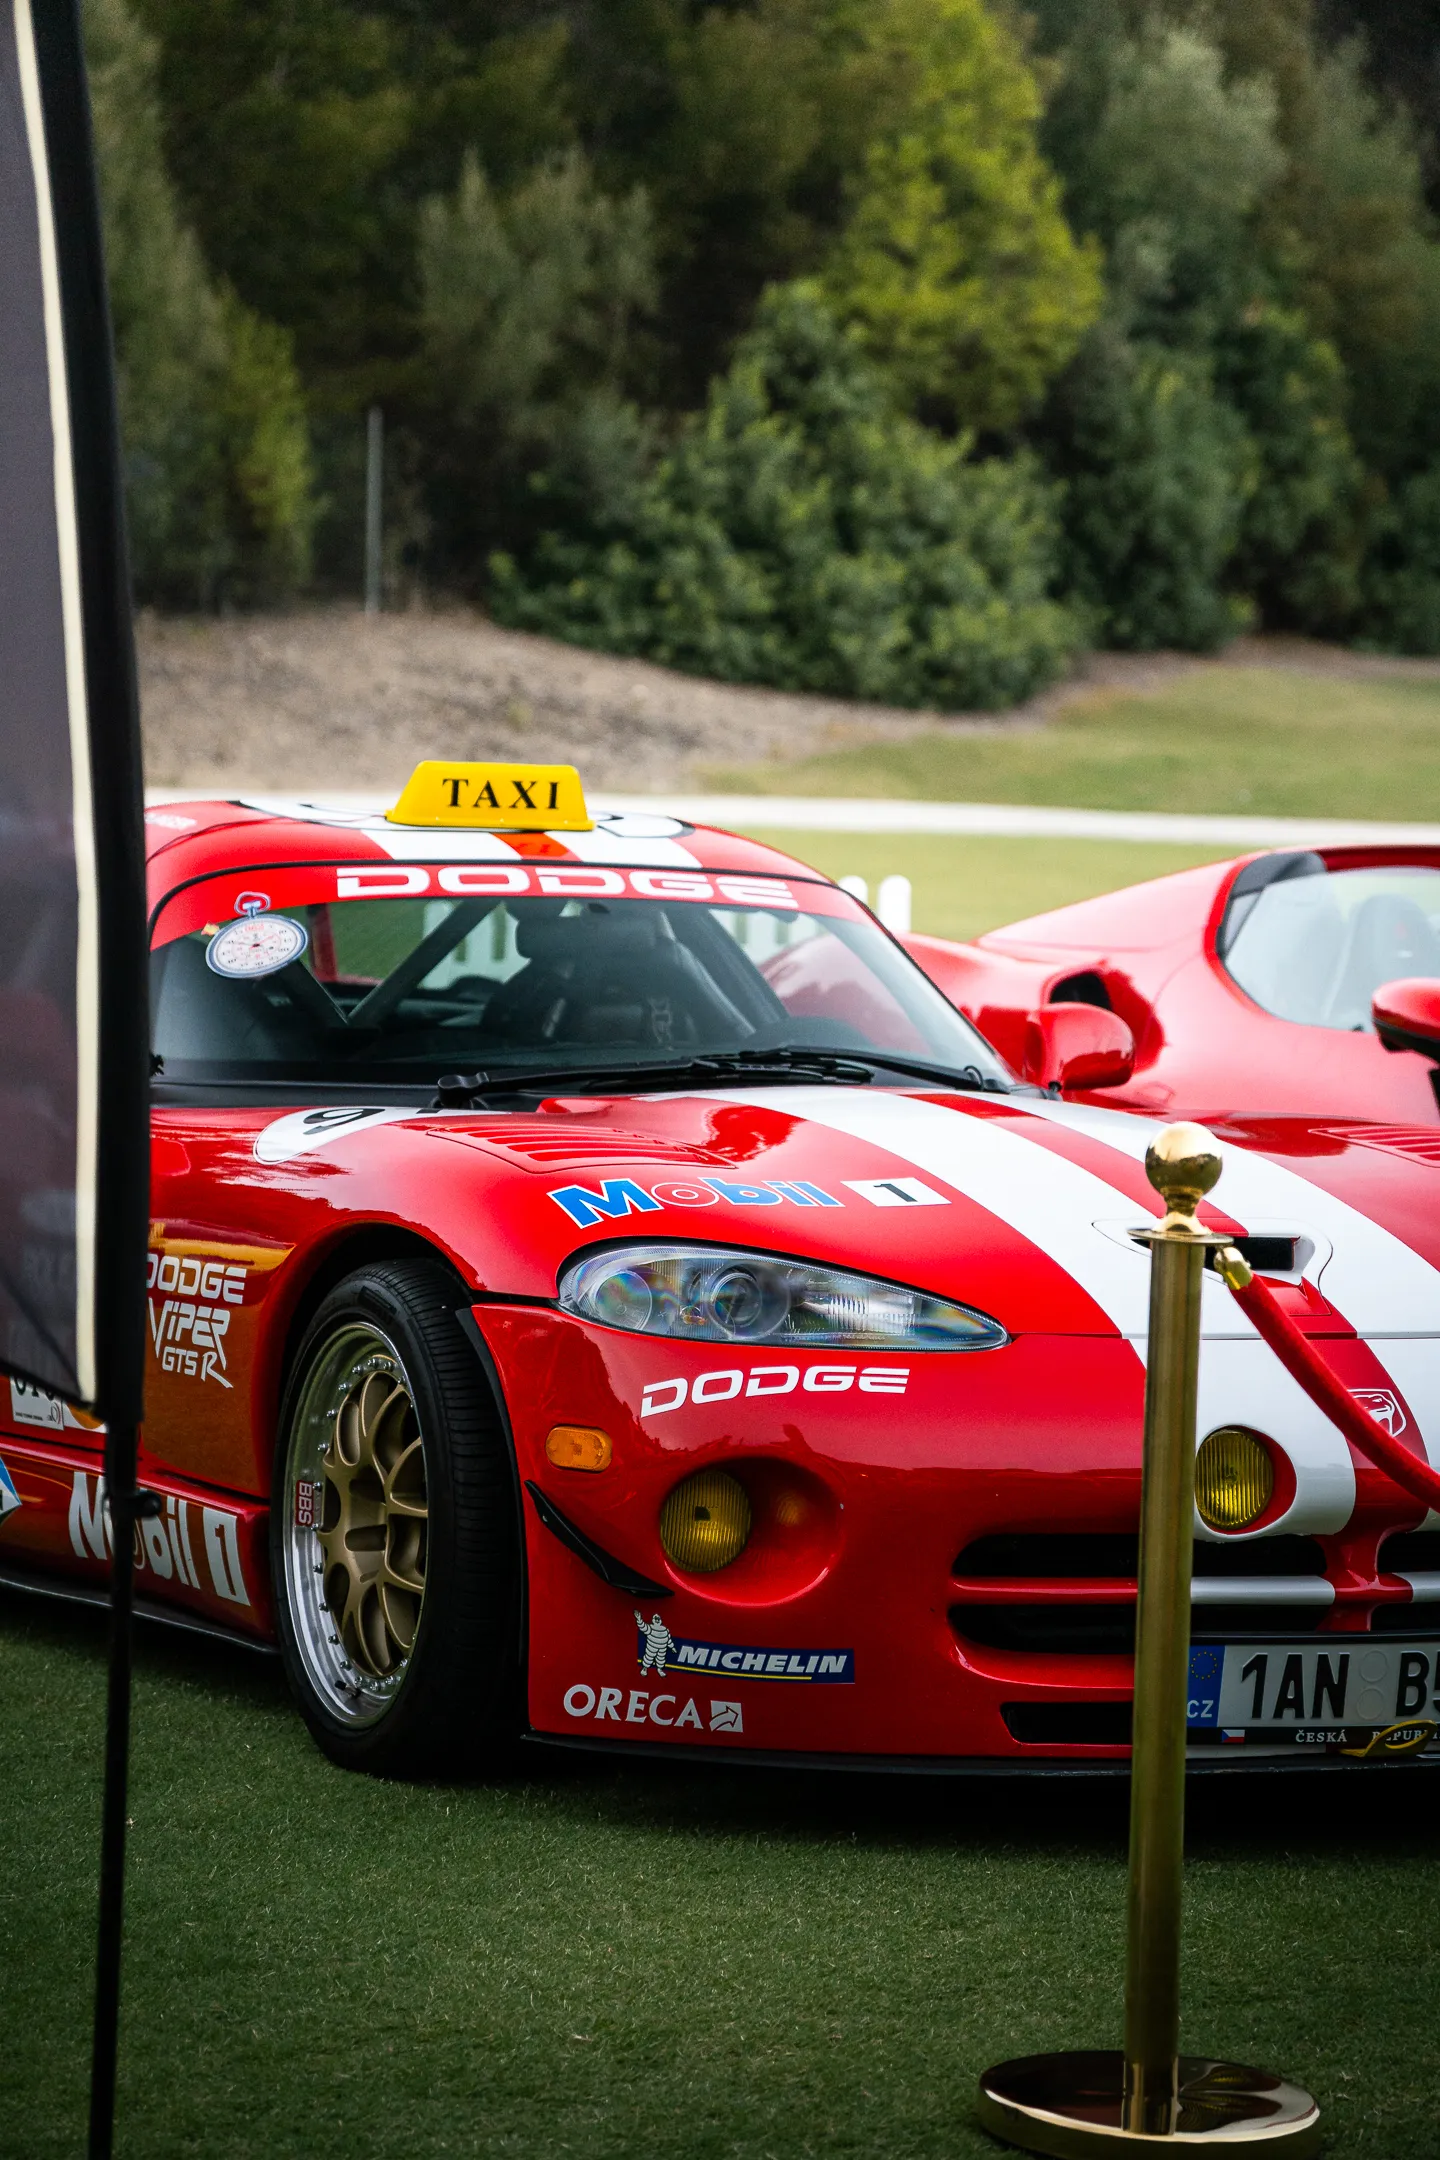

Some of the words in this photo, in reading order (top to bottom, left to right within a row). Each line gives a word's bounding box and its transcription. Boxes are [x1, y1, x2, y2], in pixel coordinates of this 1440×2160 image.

[441, 777, 560, 811] TAXI
[336, 866, 800, 909] DODGE
[547, 1177, 846, 1229] Mobil
[148, 1296, 231, 1371] VIPER
[640, 1365, 910, 1418] DODGE
[299, 1481, 312, 1526] BBS
[676, 1645, 847, 1674] MICHELIN
[563, 1684, 704, 1730] ORECA
[1241, 1652, 1350, 1720] 1AN
[1395, 1650, 1440, 1717] B
[1186, 1699, 1214, 1719] CZ
[1295, 1729, 1348, 1743] ČESKÁ
